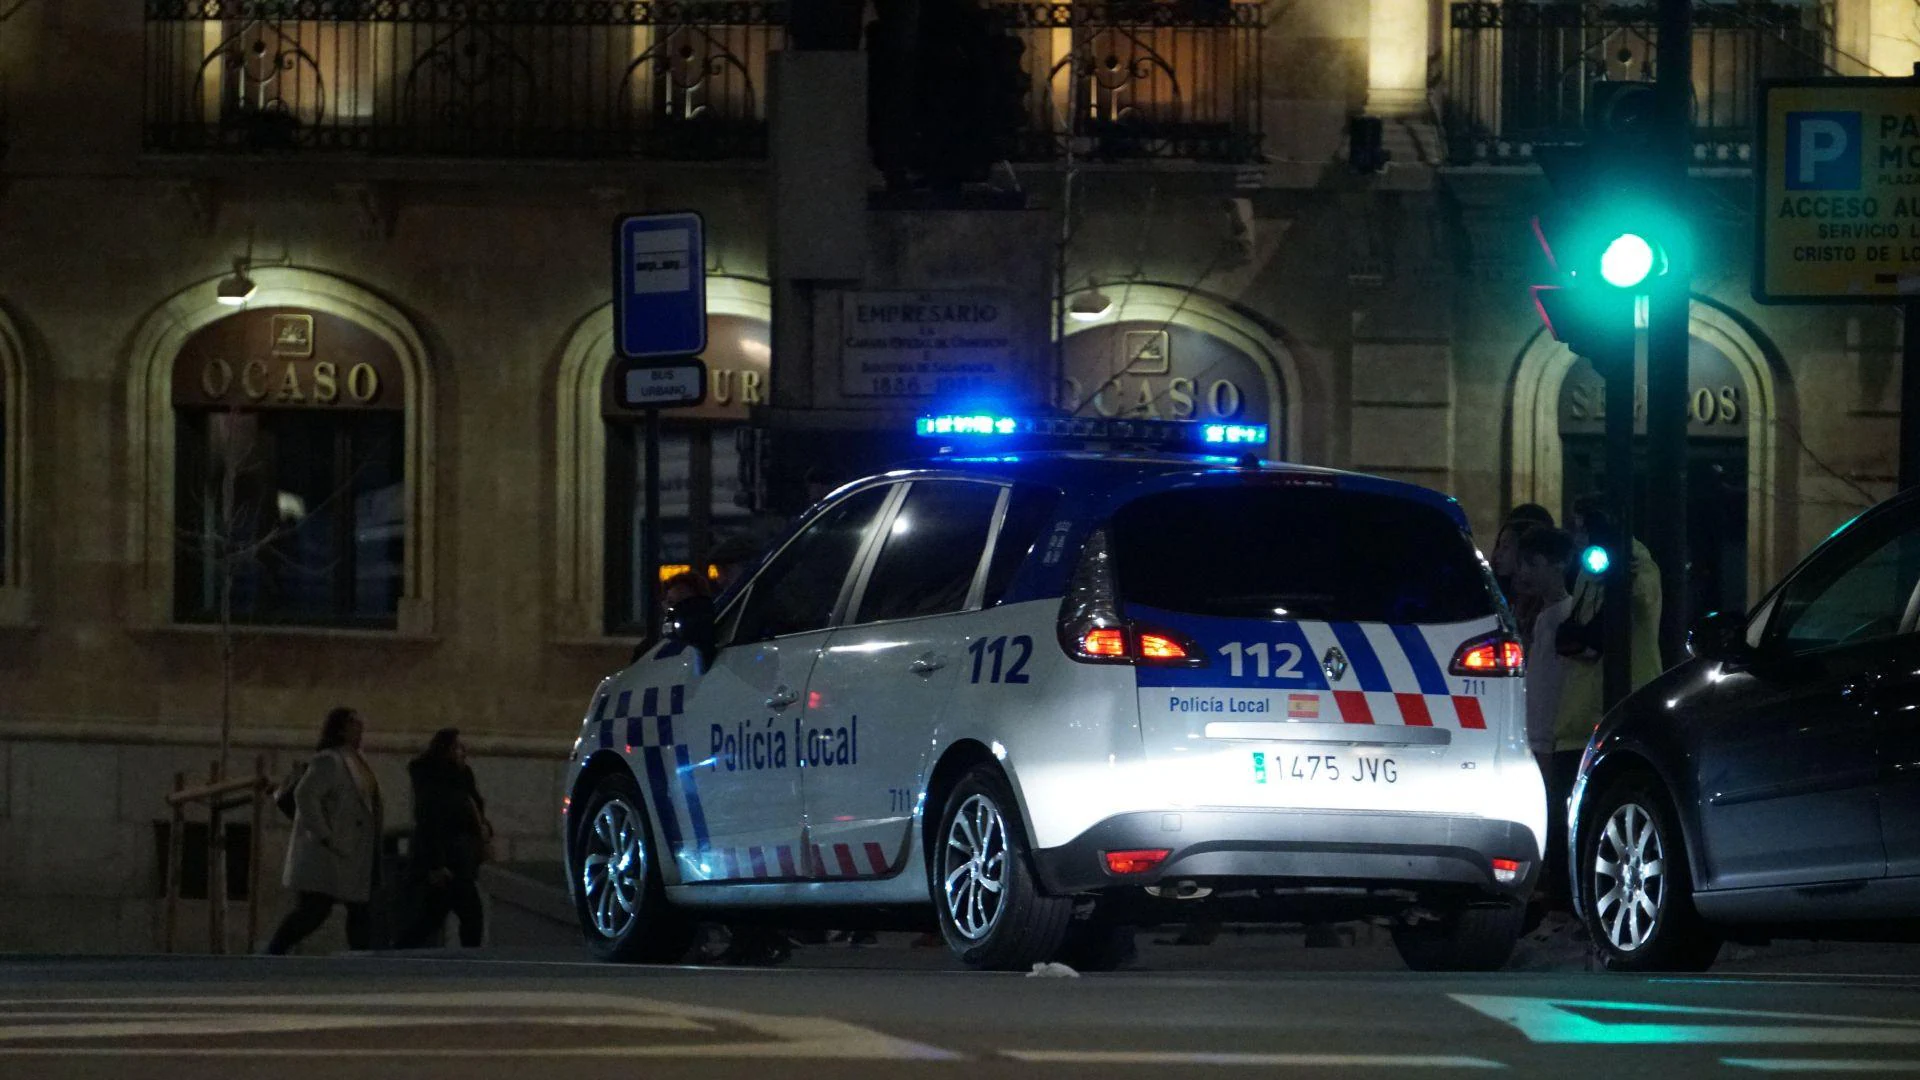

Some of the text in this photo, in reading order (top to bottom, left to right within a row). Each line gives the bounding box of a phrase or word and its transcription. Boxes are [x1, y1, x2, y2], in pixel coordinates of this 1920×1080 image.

[1779, 197, 1878, 217] ACCESO
[1818, 223, 1899, 239] SERVICIO
[1793, 246, 1856, 262] CRISTO
[1867, 246, 1890, 262] DE
[857, 303, 999, 323] EMPRESARIO
[202, 358, 379, 402] OCASO
[651, 370, 674, 380] BUS
[641, 385, 687, 397] URBANO
[968, 635, 1033, 683] 112
[1217, 641, 1304, 679] 112
[1462, 679, 1485, 695] 711
[1170, 696, 1269, 713] Policía Local
[711, 714, 857, 772] Policía Local
[1276, 755, 1398, 783] 1475 JVG
[889, 789, 911, 812] 711
